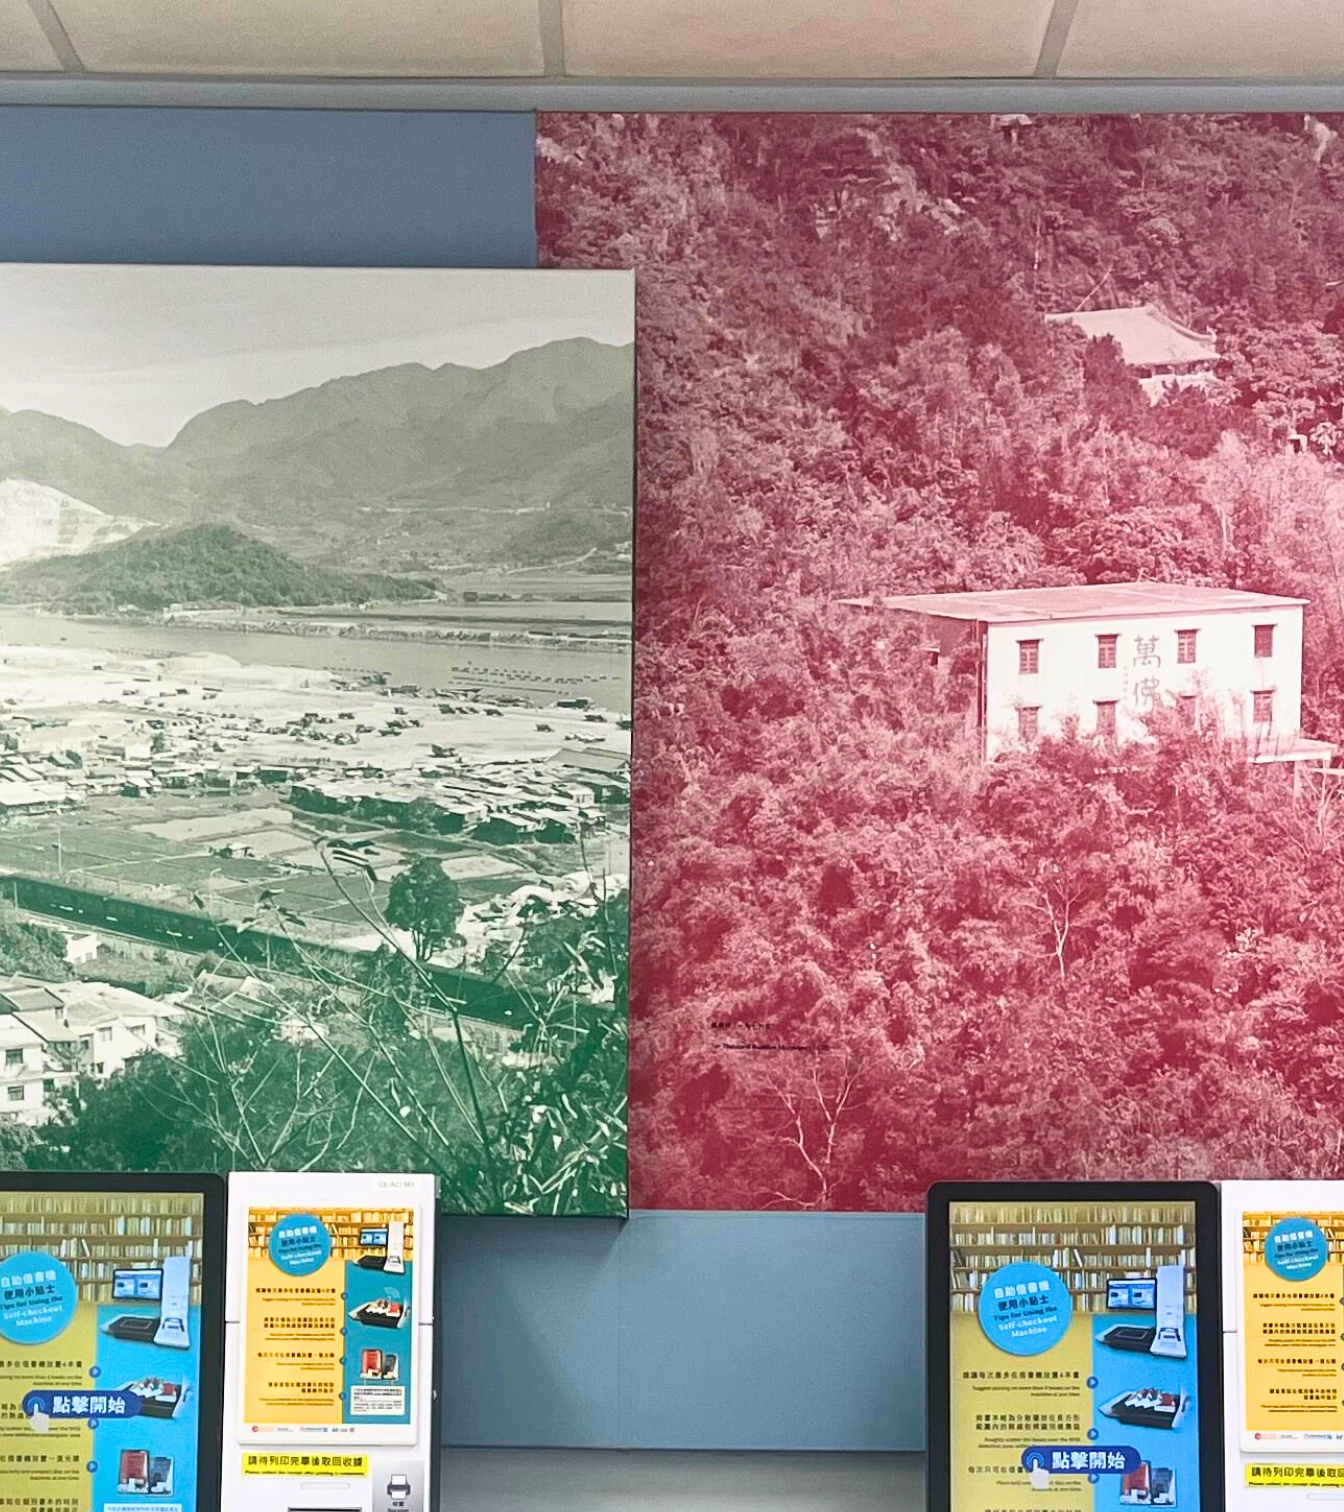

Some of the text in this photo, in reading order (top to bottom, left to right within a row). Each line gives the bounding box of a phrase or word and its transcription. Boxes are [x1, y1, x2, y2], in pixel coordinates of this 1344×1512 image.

[0, 1269, 57, 1288] 自助借書機
[4, 1284, 56, 1300] 使用小貼士
[994, 1280, 1050, 1299] 自助借書機
[998, 1295, 1049, 1312] 使用小貼士
[52, 1396, 126, 1415] 點擊開始
[248, 1455, 363, 1467] 請待列印完畢後取回收據
[1052, 1451, 1125, 1470] 點擊開始
